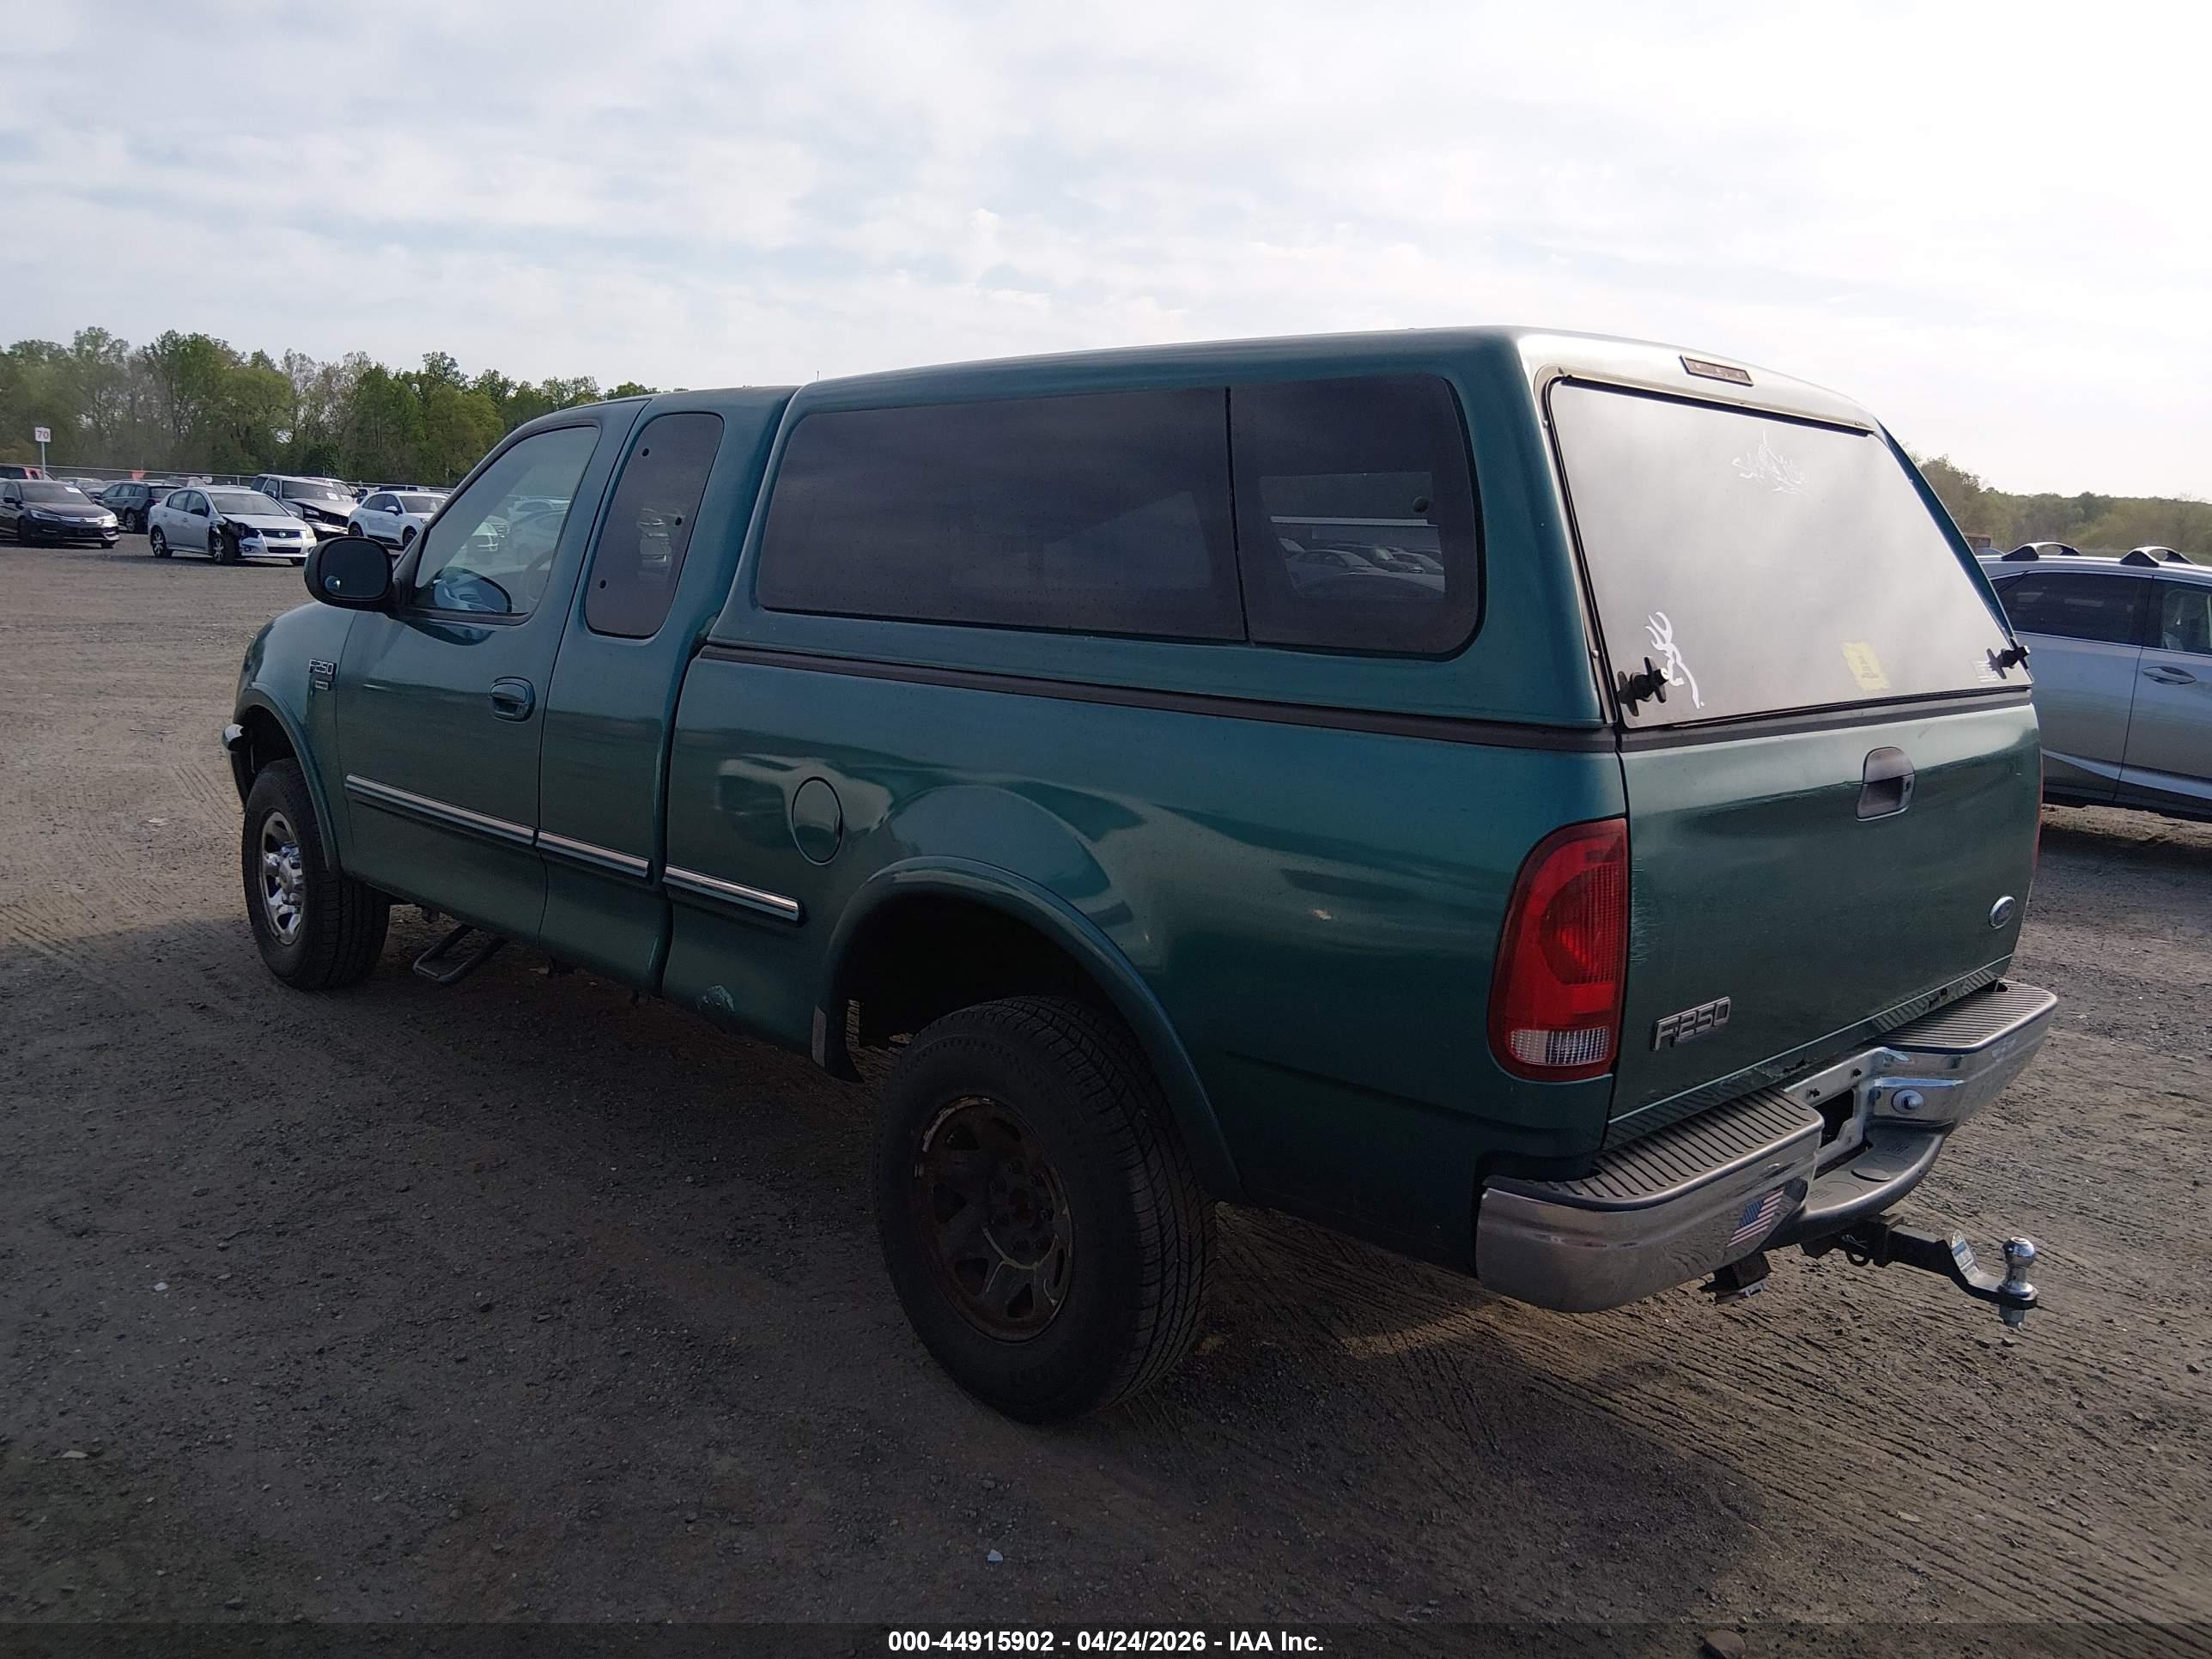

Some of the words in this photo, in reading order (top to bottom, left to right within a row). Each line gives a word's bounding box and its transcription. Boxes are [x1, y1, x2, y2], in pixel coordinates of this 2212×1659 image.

[37, 430, 49, 440] 70
[309, 659, 334, 675] F250
[1655, 997, 1731, 1051] F250
